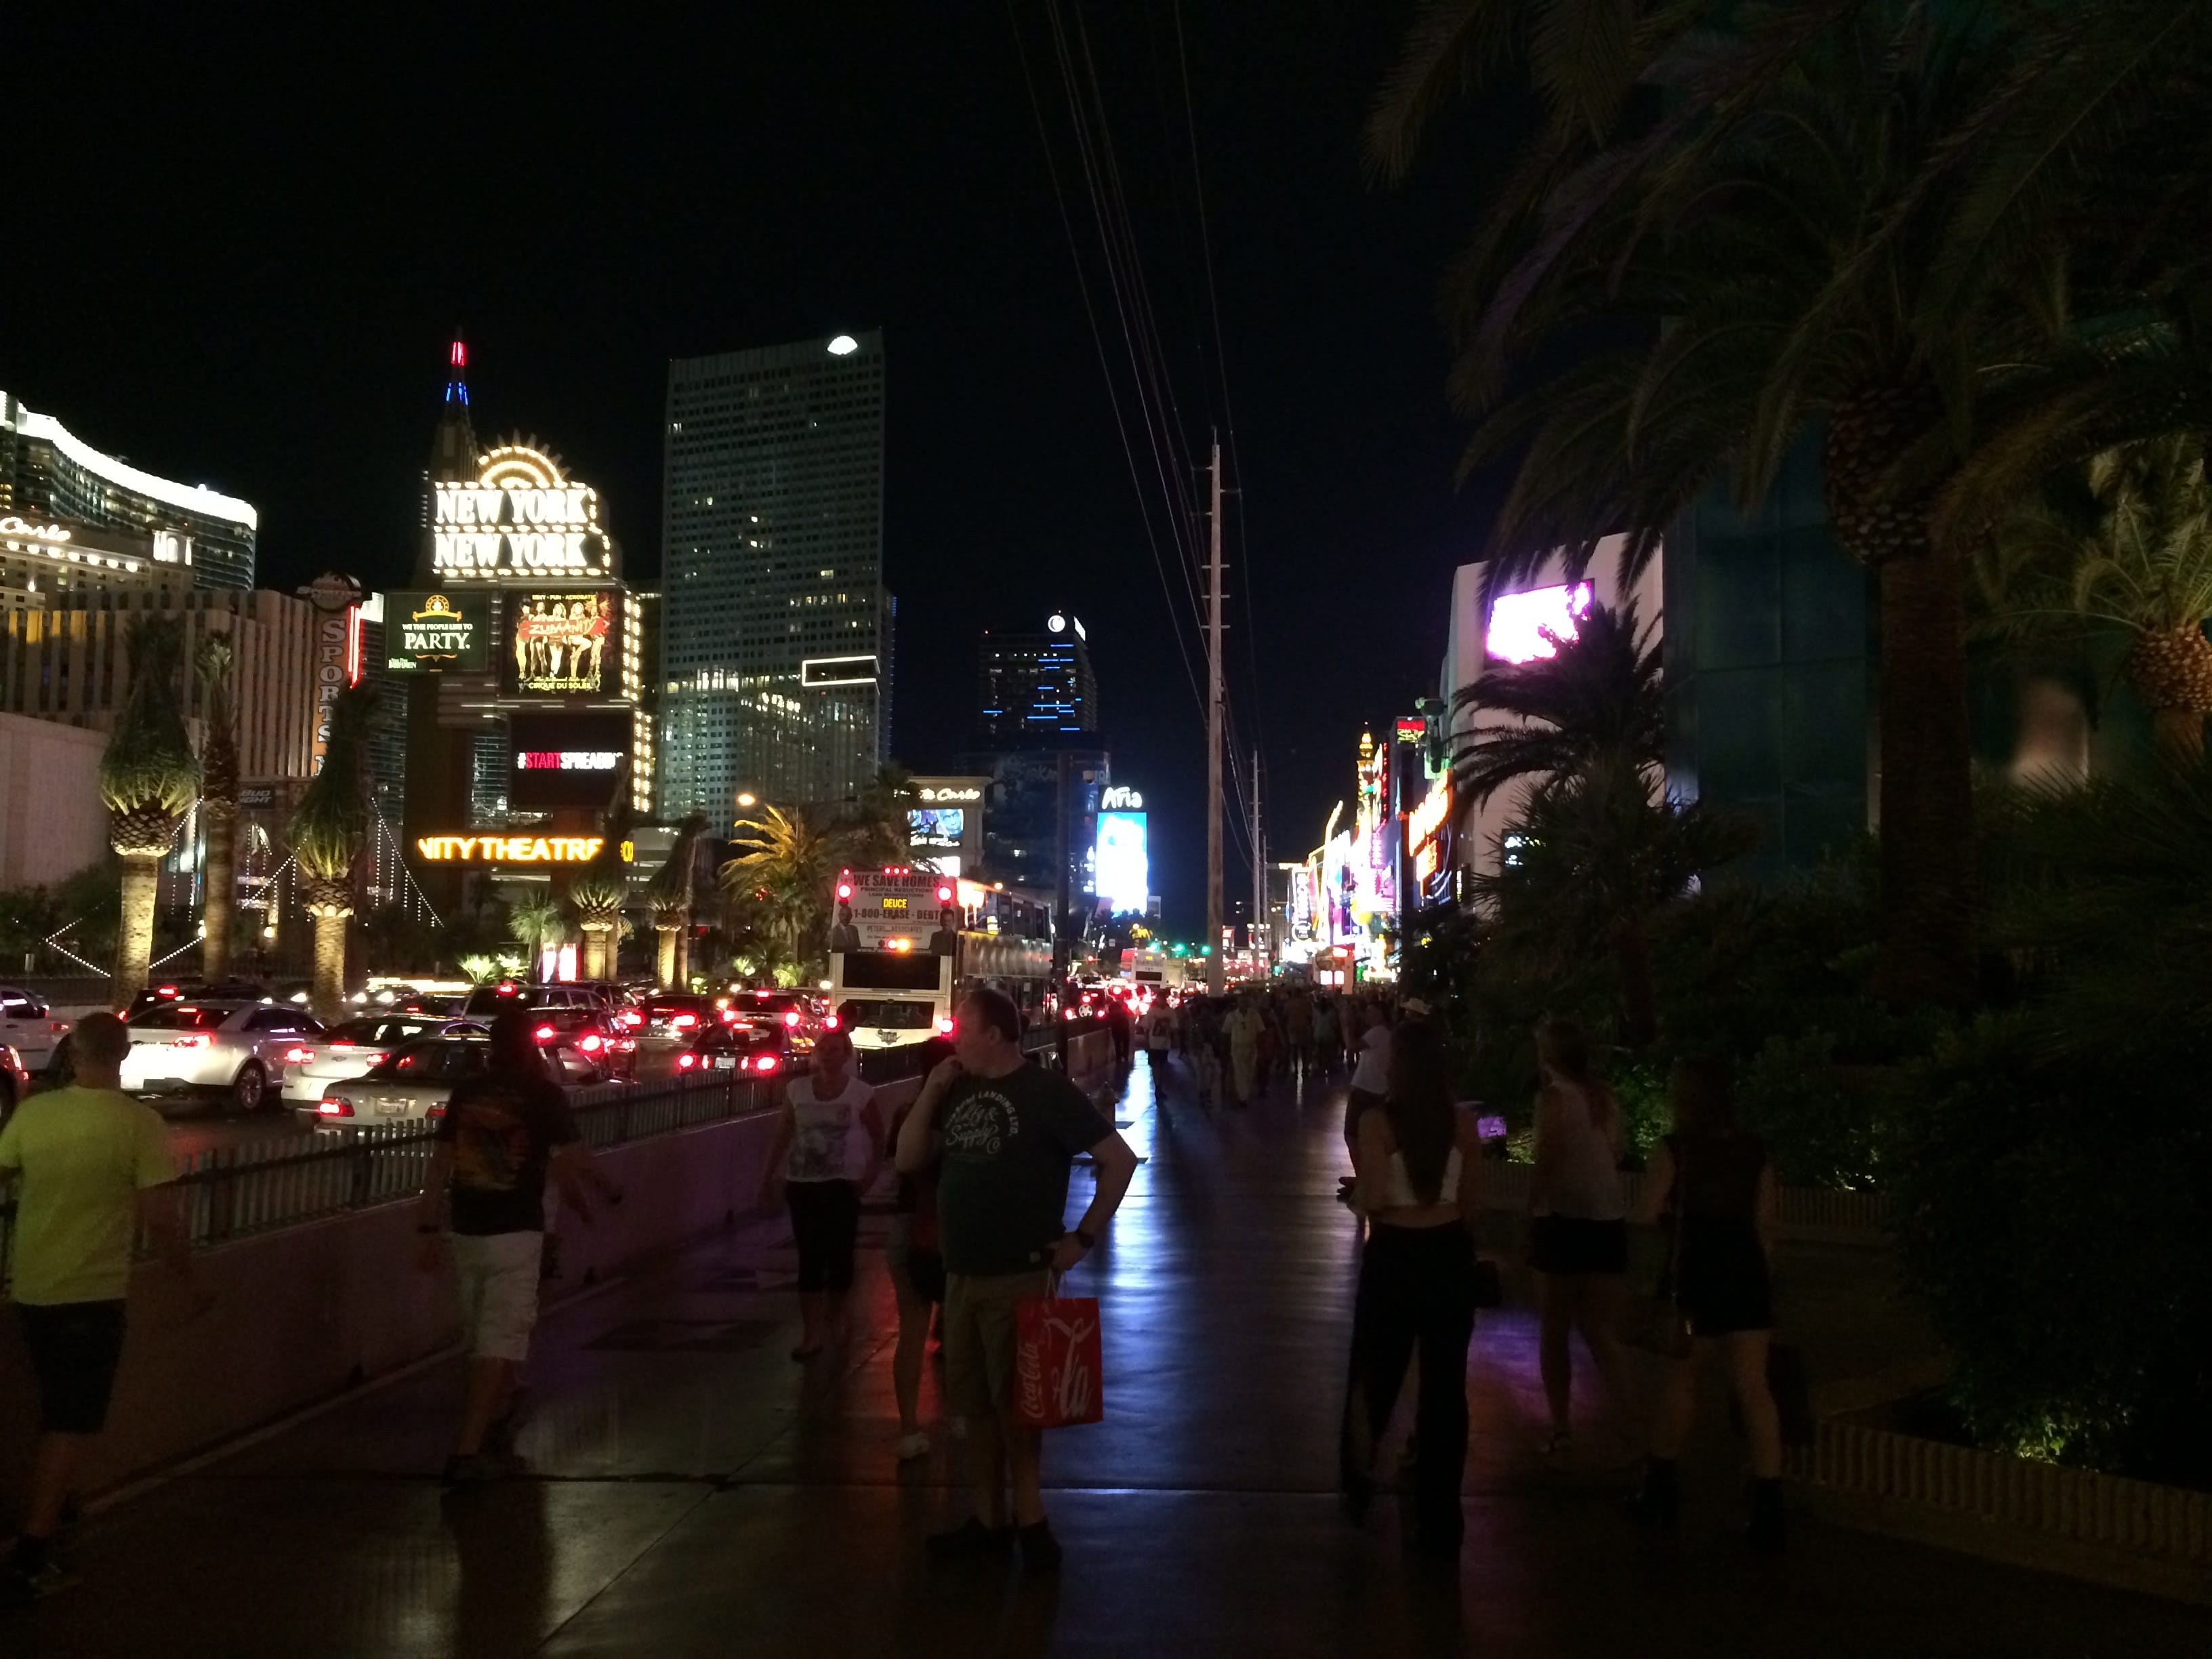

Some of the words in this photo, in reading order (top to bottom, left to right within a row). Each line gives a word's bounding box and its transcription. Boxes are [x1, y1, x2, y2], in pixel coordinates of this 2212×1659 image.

[436, 489, 504, 523] NEW
[508, 489, 588, 523] YORK
[434, 533, 501, 567] NEW
[506, 533, 587, 567] YORK
[404, 632, 470, 649] PARTY.
[528, 682, 555, 691] CIRQUE
[1101, 786, 1143, 809] Aria
[853, 874, 870, 886] WE
[872, 875, 897, 886] SAVE
[883, 898, 907, 908] DEUCE
[916, 910, 940, 920] DEBT
[978, 1090, 1015, 1115] LANDING
[945, 1122, 998, 1149] Supply
